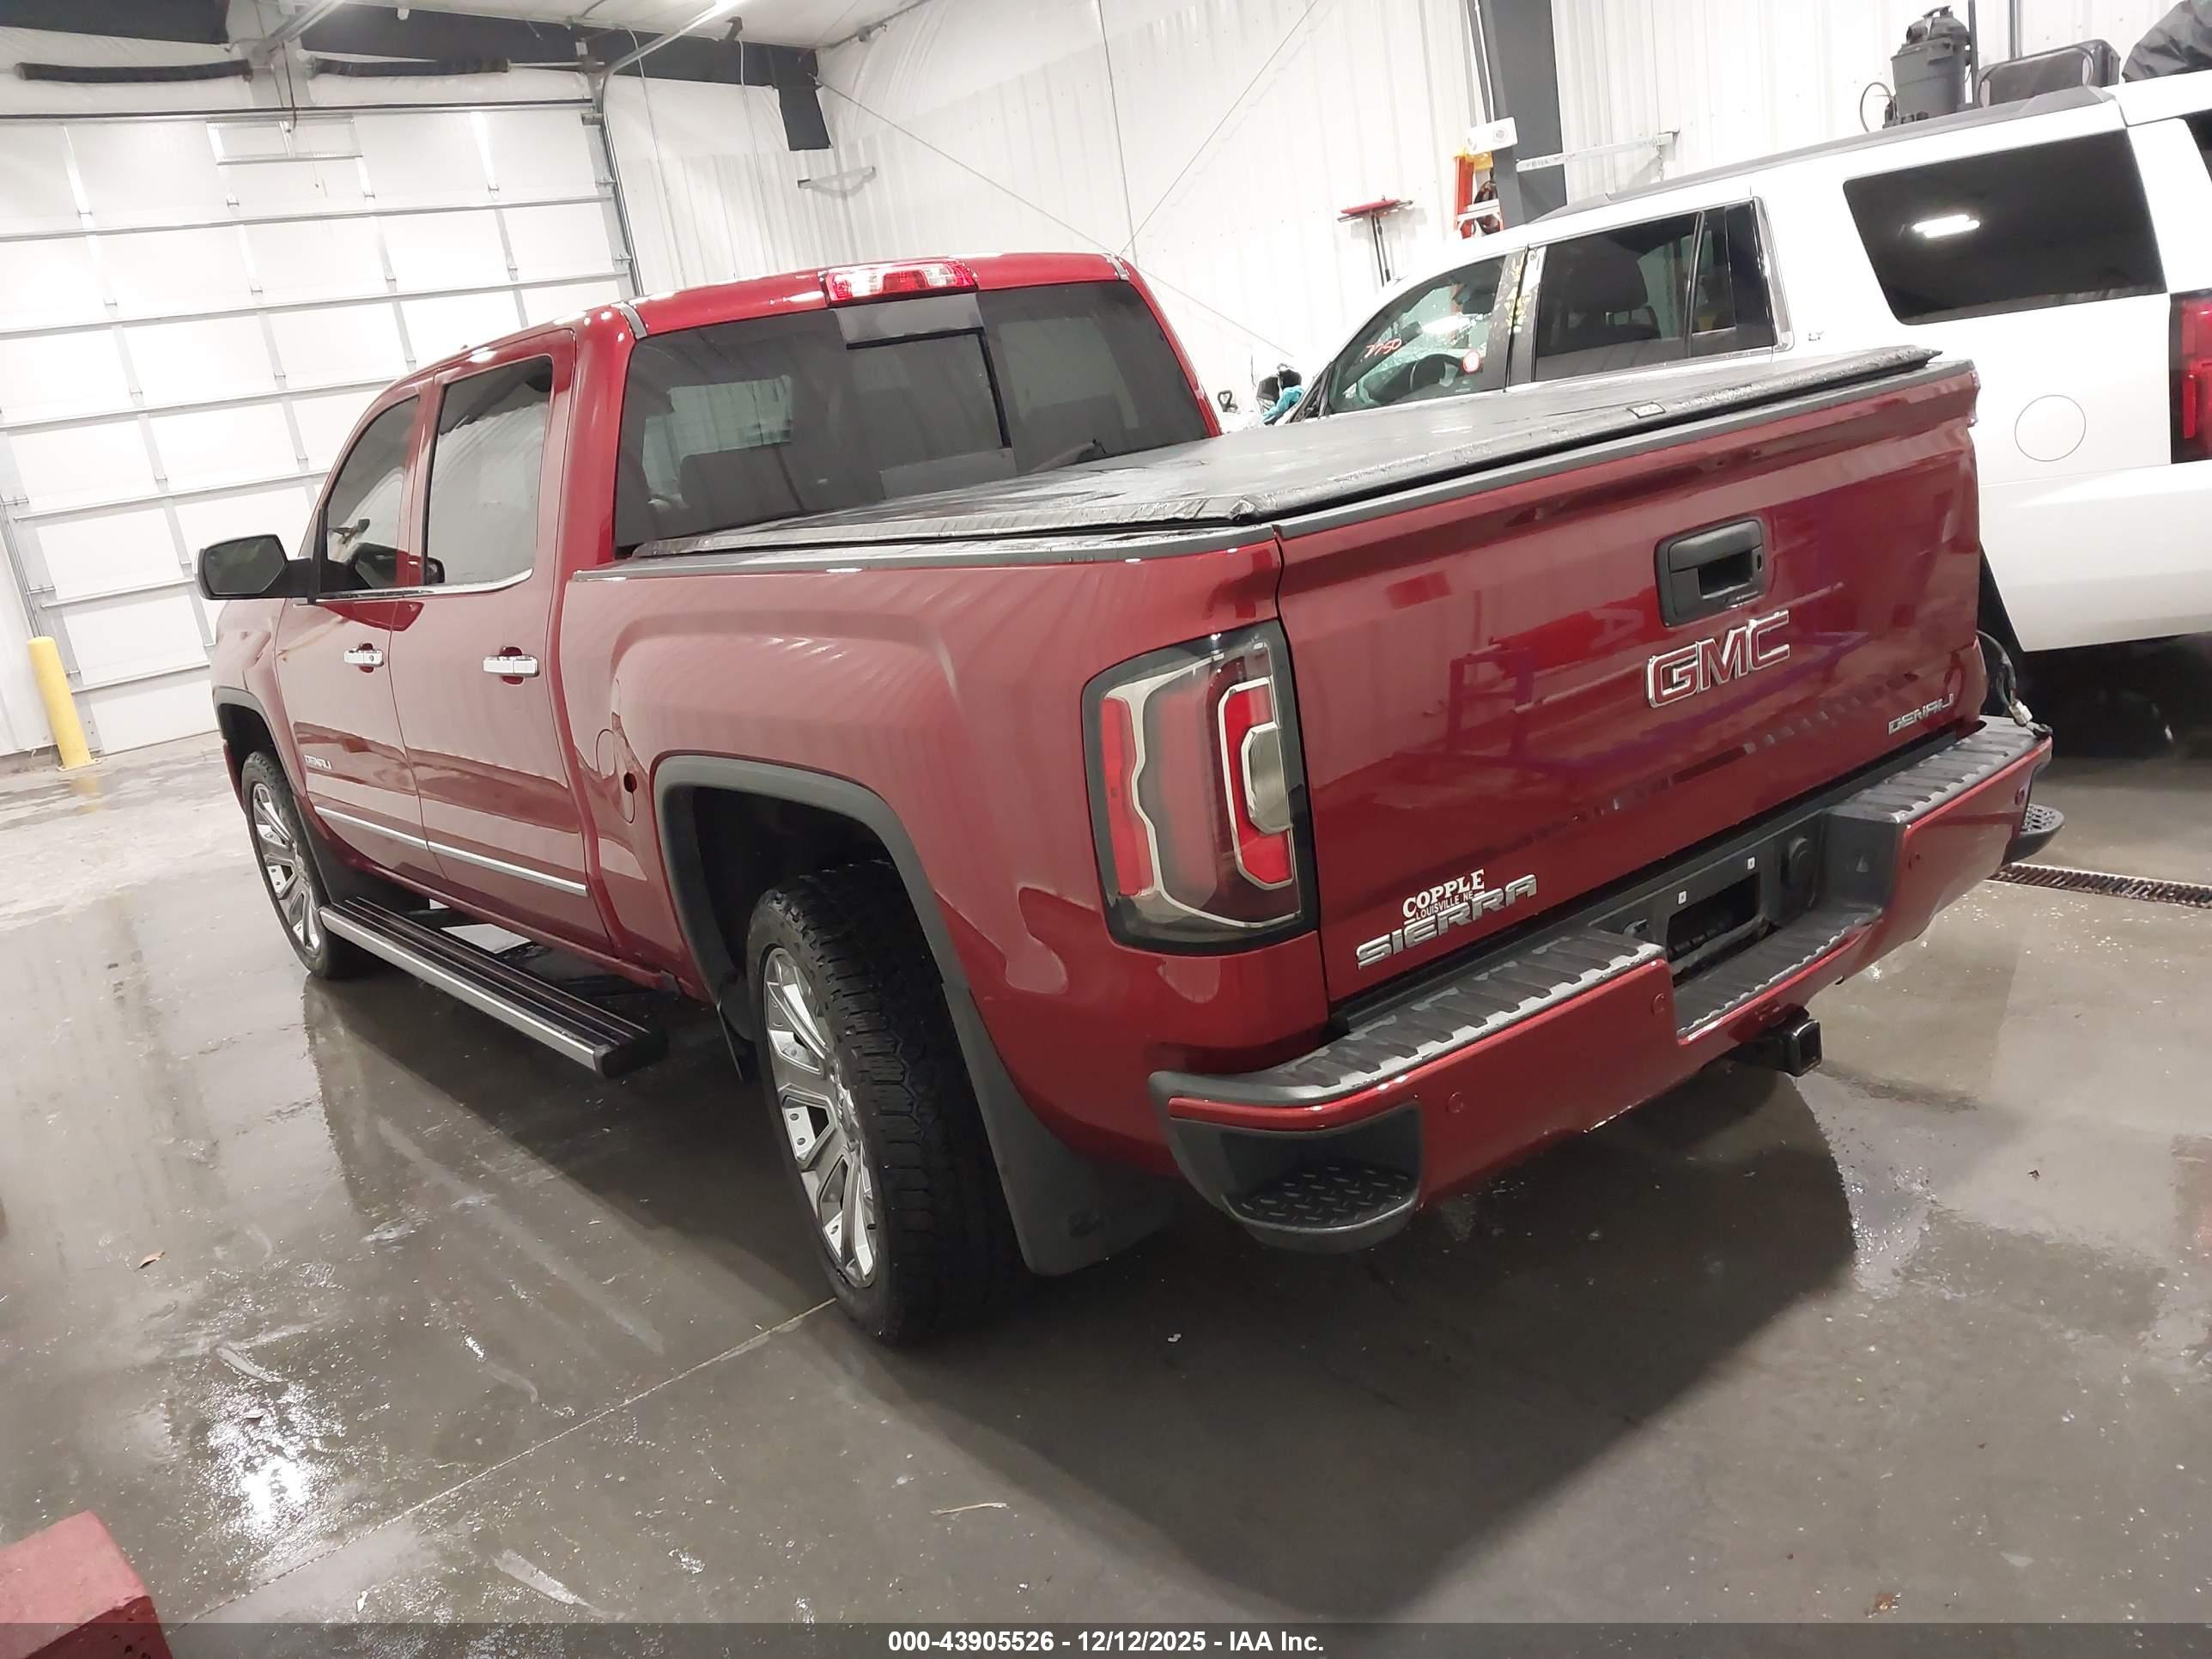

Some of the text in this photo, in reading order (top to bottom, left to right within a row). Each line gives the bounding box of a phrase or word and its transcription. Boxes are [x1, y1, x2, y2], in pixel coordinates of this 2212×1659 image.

[1646, 609, 1790, 708] GMC
[1355, 873, 1537, 970] SIERRA
[1402, 868, 1485, 918] COPPLE
[1416, 890, 1474, 920] LOUISVILLE NE
